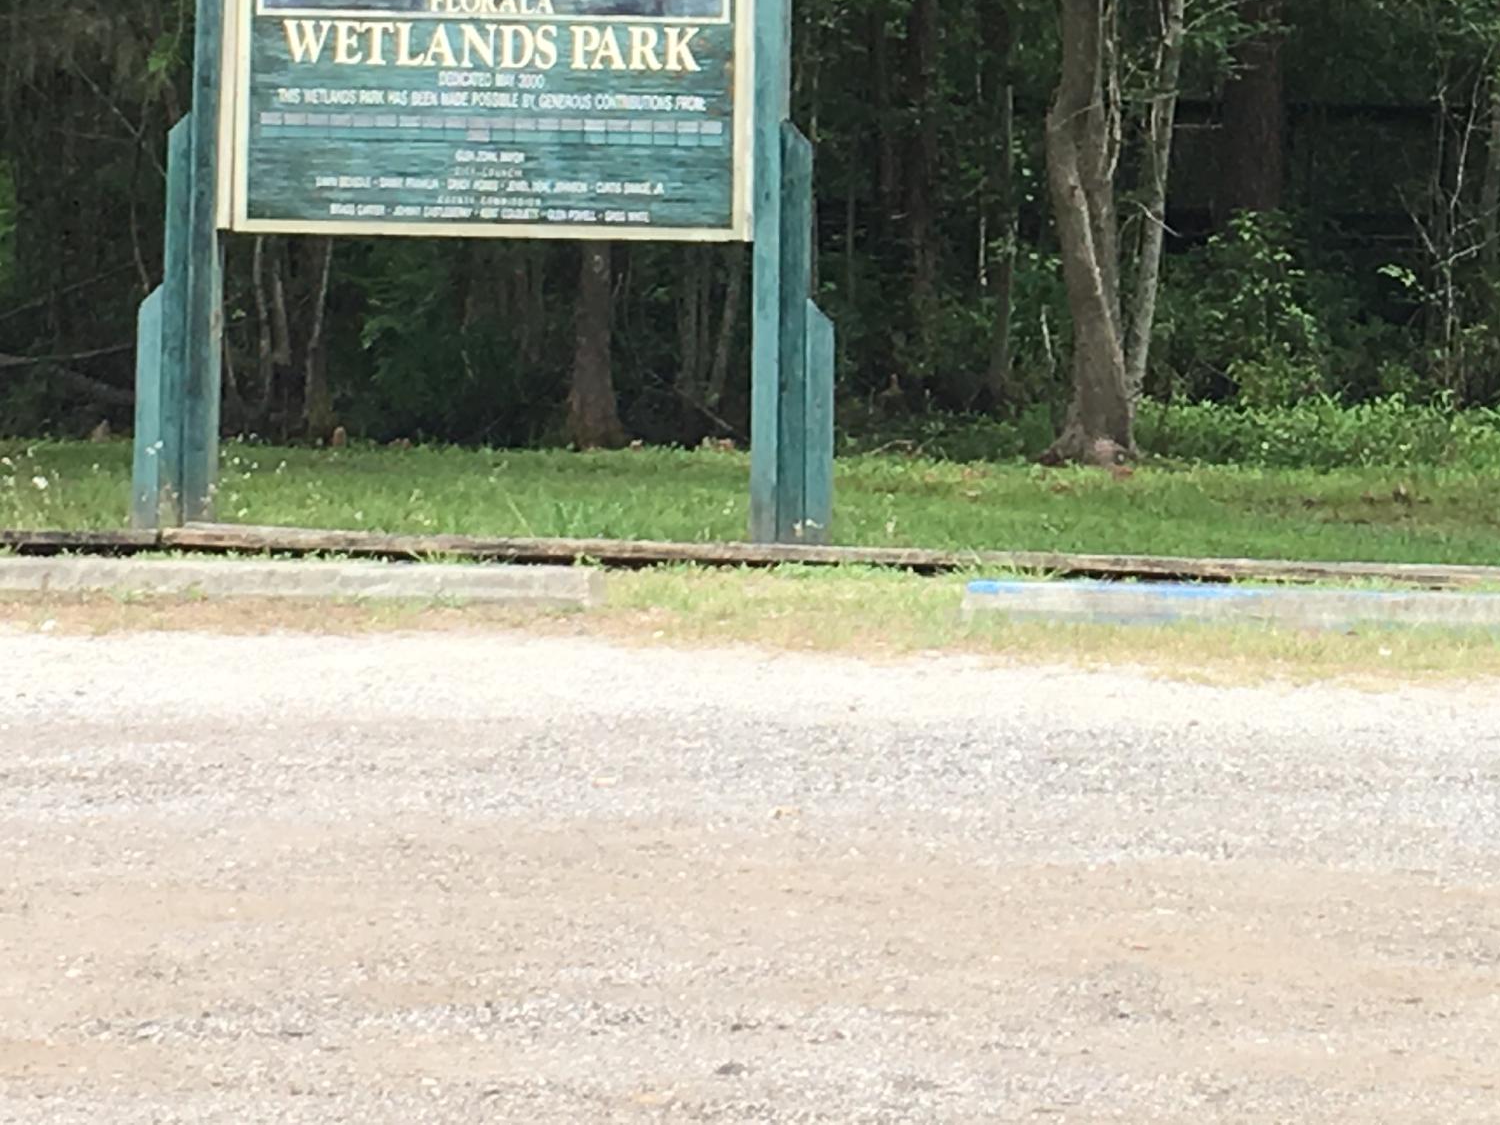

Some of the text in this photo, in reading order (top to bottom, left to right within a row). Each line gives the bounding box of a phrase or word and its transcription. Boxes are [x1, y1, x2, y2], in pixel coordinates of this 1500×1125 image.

[283, 19, 700, 71] WETLANDS PARK
[303, 88, 357, 104] WETLANDS
[359, 89, 385, 104] PARK
[387, 90, 408, 105] HAS
[410, 91, 438, 106] BEEN
[471, 92, 518, 108] POSSIBLE
[538, 94, 591, 110] GENEROUS
[595, 95, 671, 111] CONTRIBUTIONS
